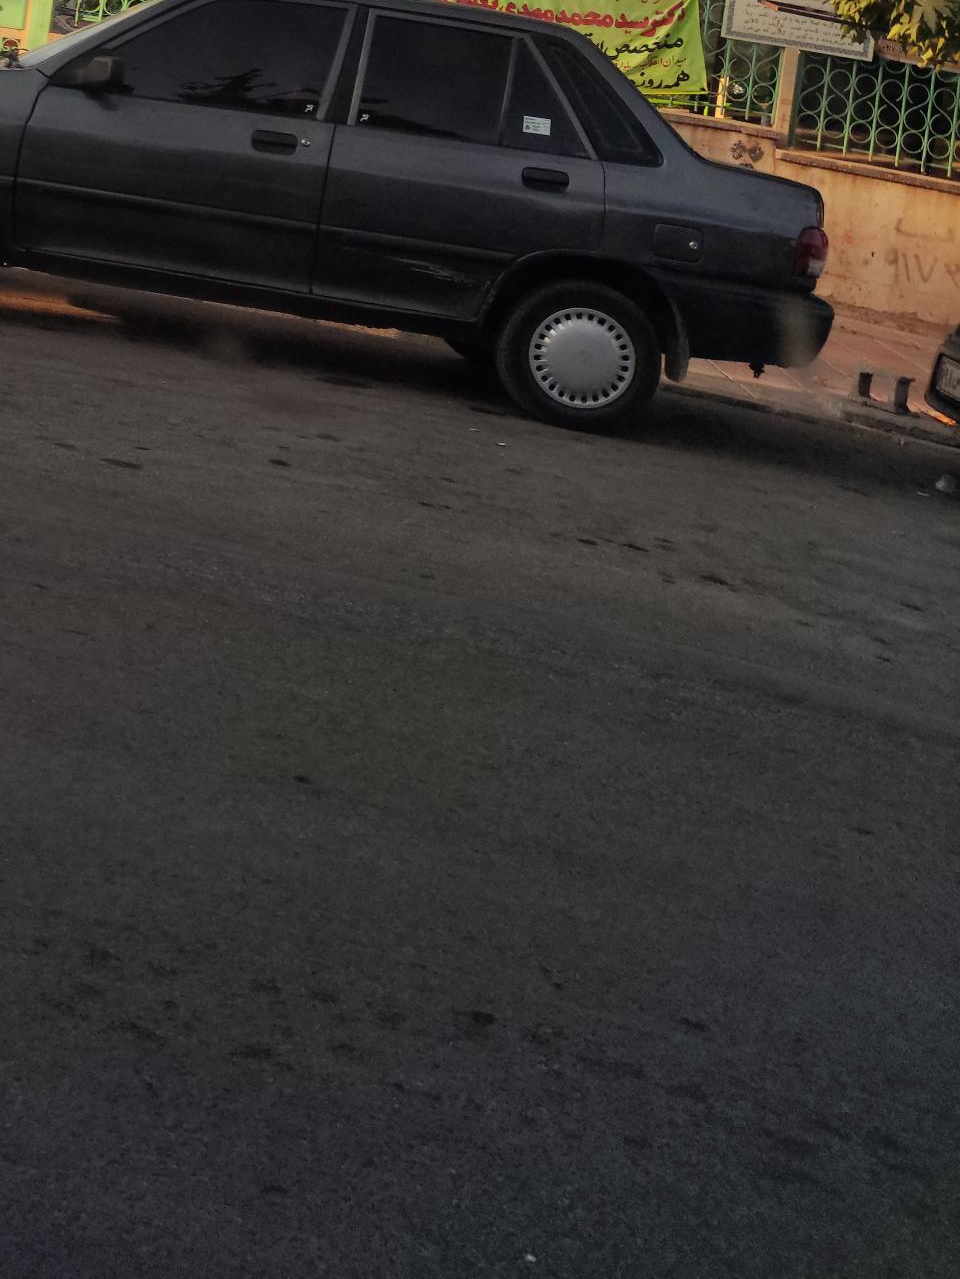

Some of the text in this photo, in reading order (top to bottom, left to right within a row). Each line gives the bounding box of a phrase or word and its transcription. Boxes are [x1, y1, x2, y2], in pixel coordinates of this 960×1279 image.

[555, 9, 614, 28] محمد
[615, 13, 650, 35] سید
[604, 33, 684, 61] متخصص
[664, 55, 687, 67] میدان
[662, 70, 690, 89] همه
